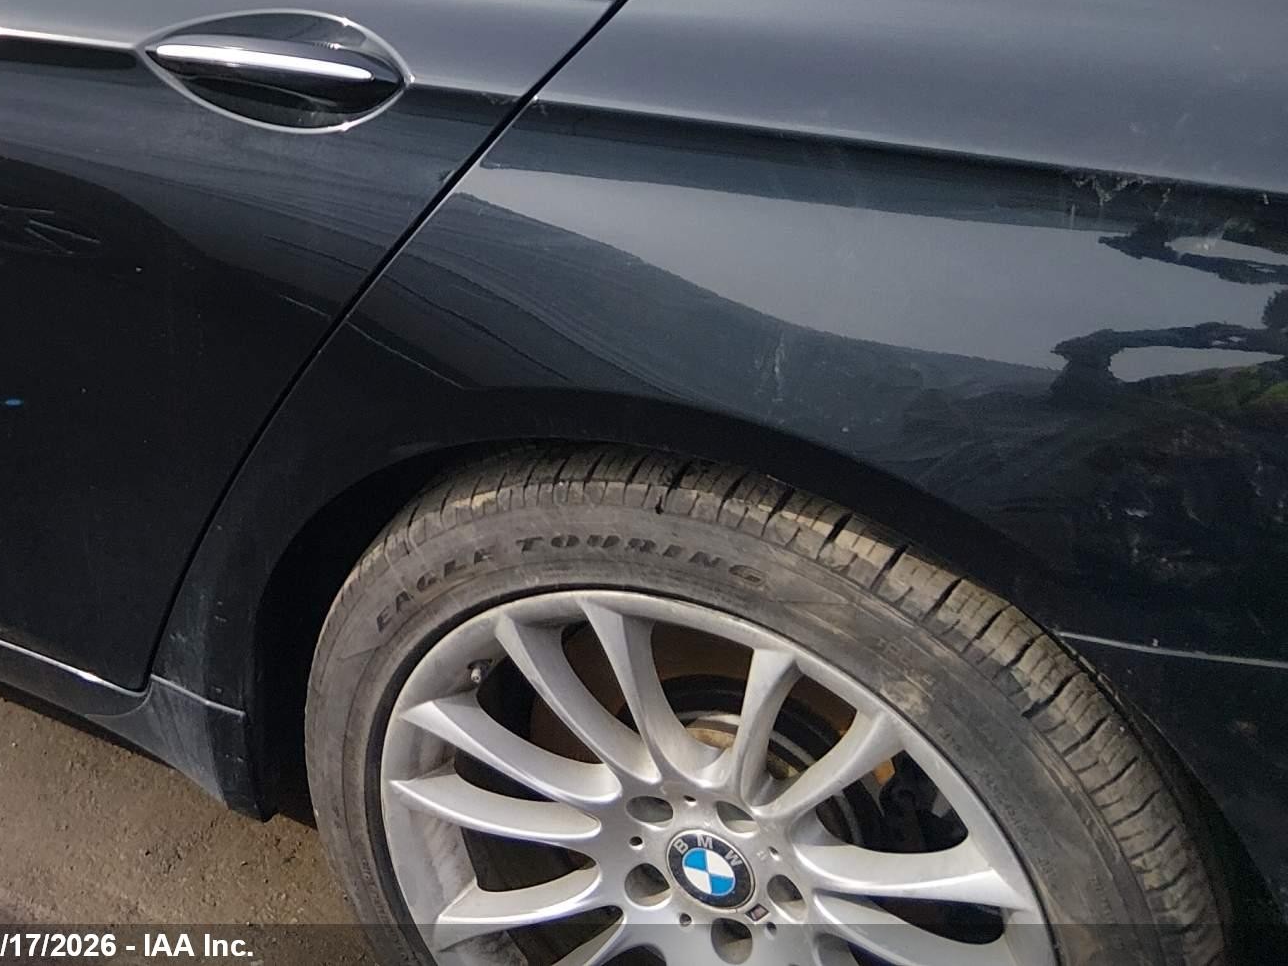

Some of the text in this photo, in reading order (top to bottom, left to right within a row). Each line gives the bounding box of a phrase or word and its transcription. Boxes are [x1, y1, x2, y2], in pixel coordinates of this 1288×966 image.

[376, 534, 769, 634] EAGLE TOURING
[673, 834, 743, 868] BMW
